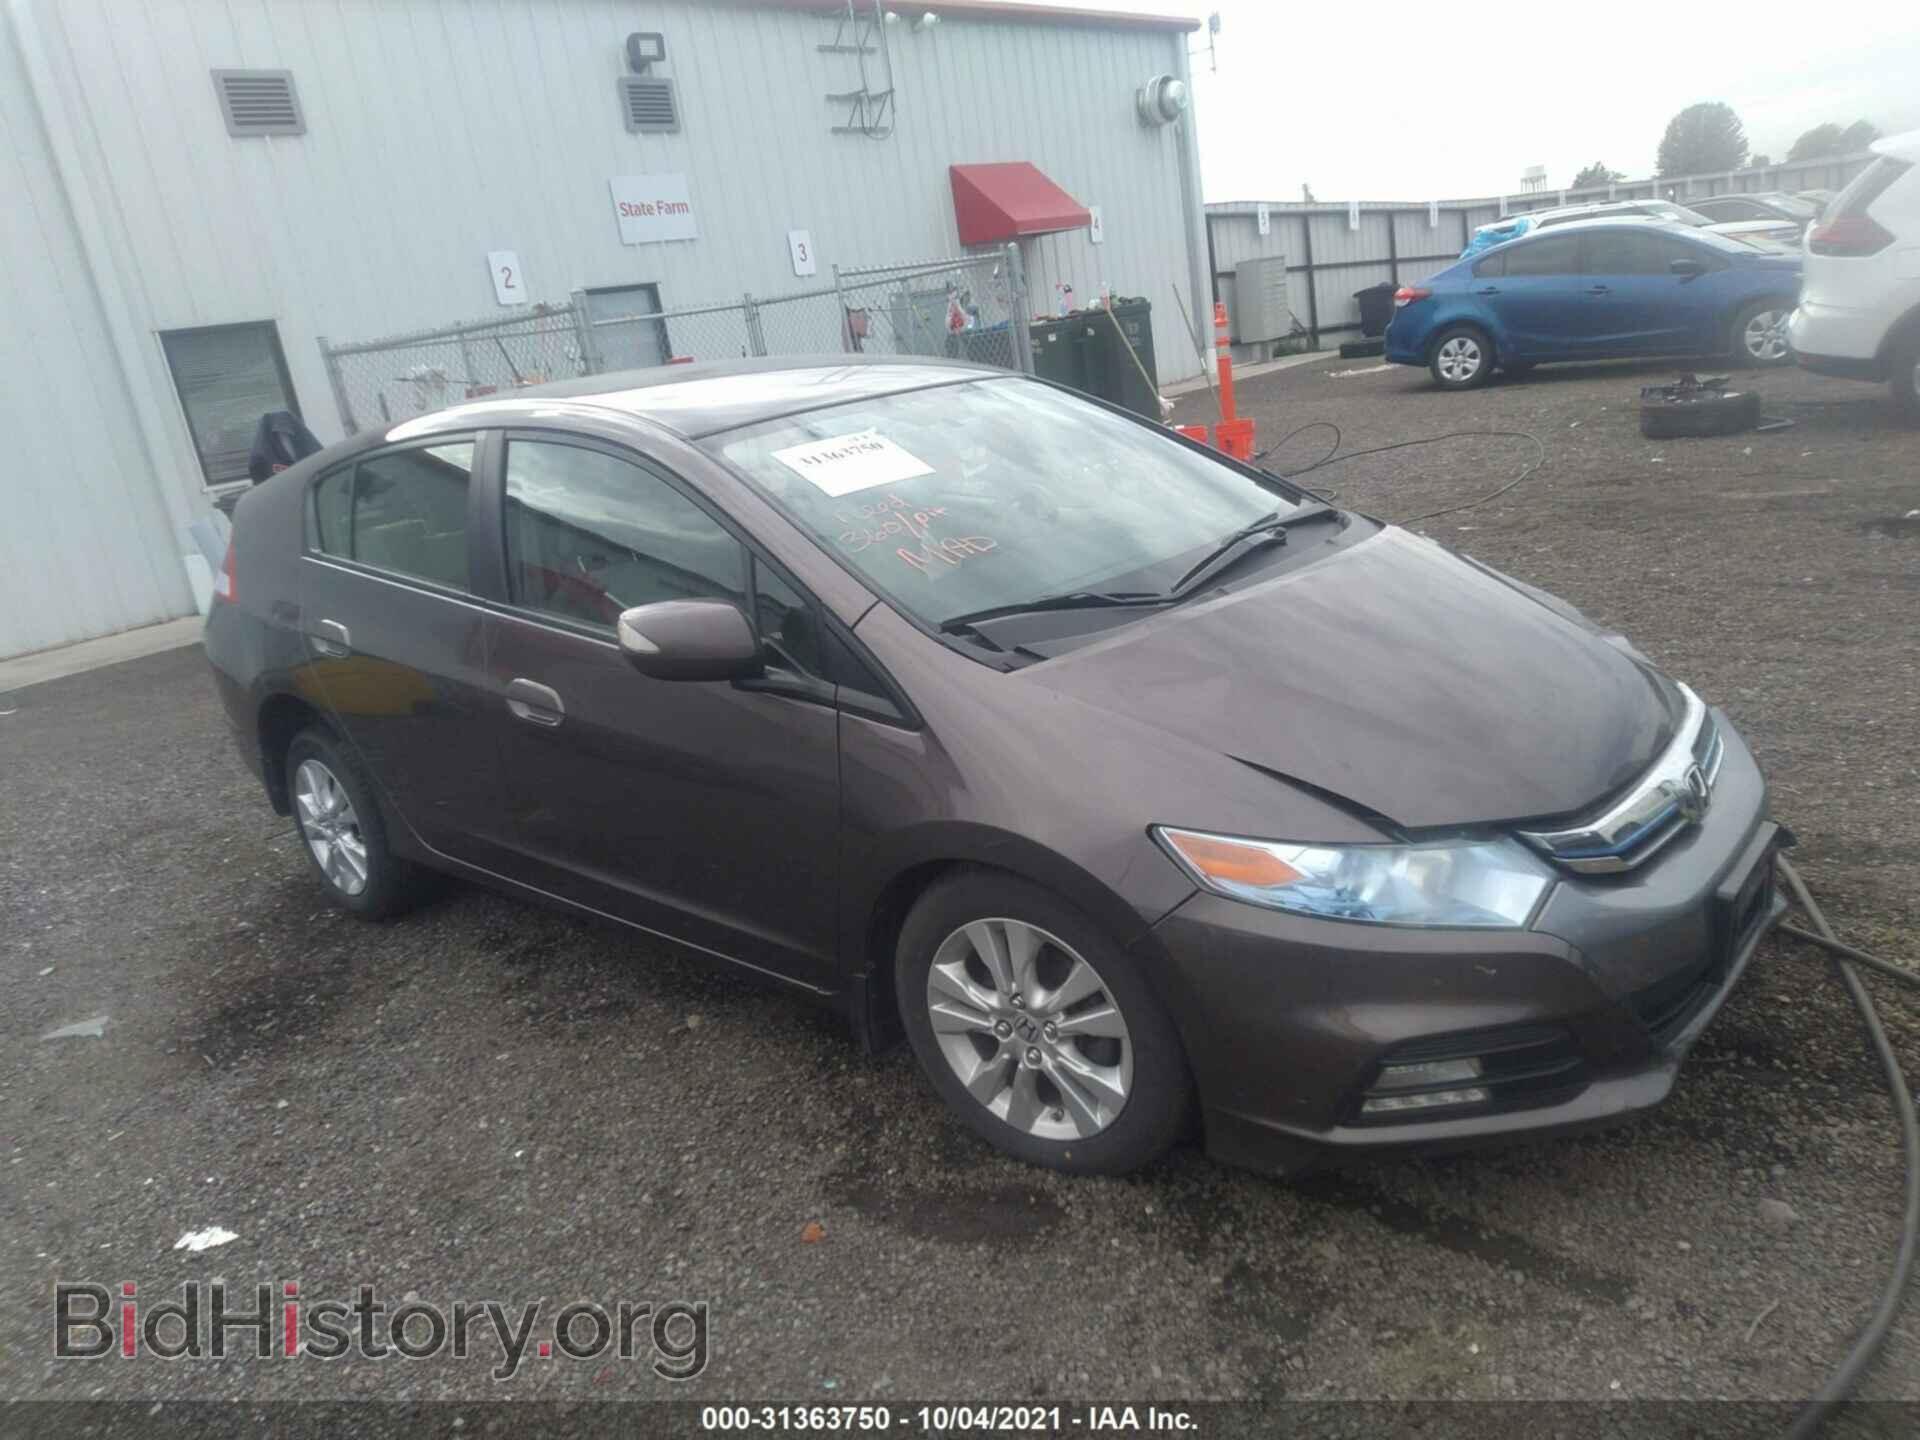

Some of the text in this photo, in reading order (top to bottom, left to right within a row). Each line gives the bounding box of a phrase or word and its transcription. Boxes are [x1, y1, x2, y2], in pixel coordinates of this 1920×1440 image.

[619, 200, 689, 217] State Farm
[797, 242, 808, 263] 3
[501, 266, 517, 290] 2
